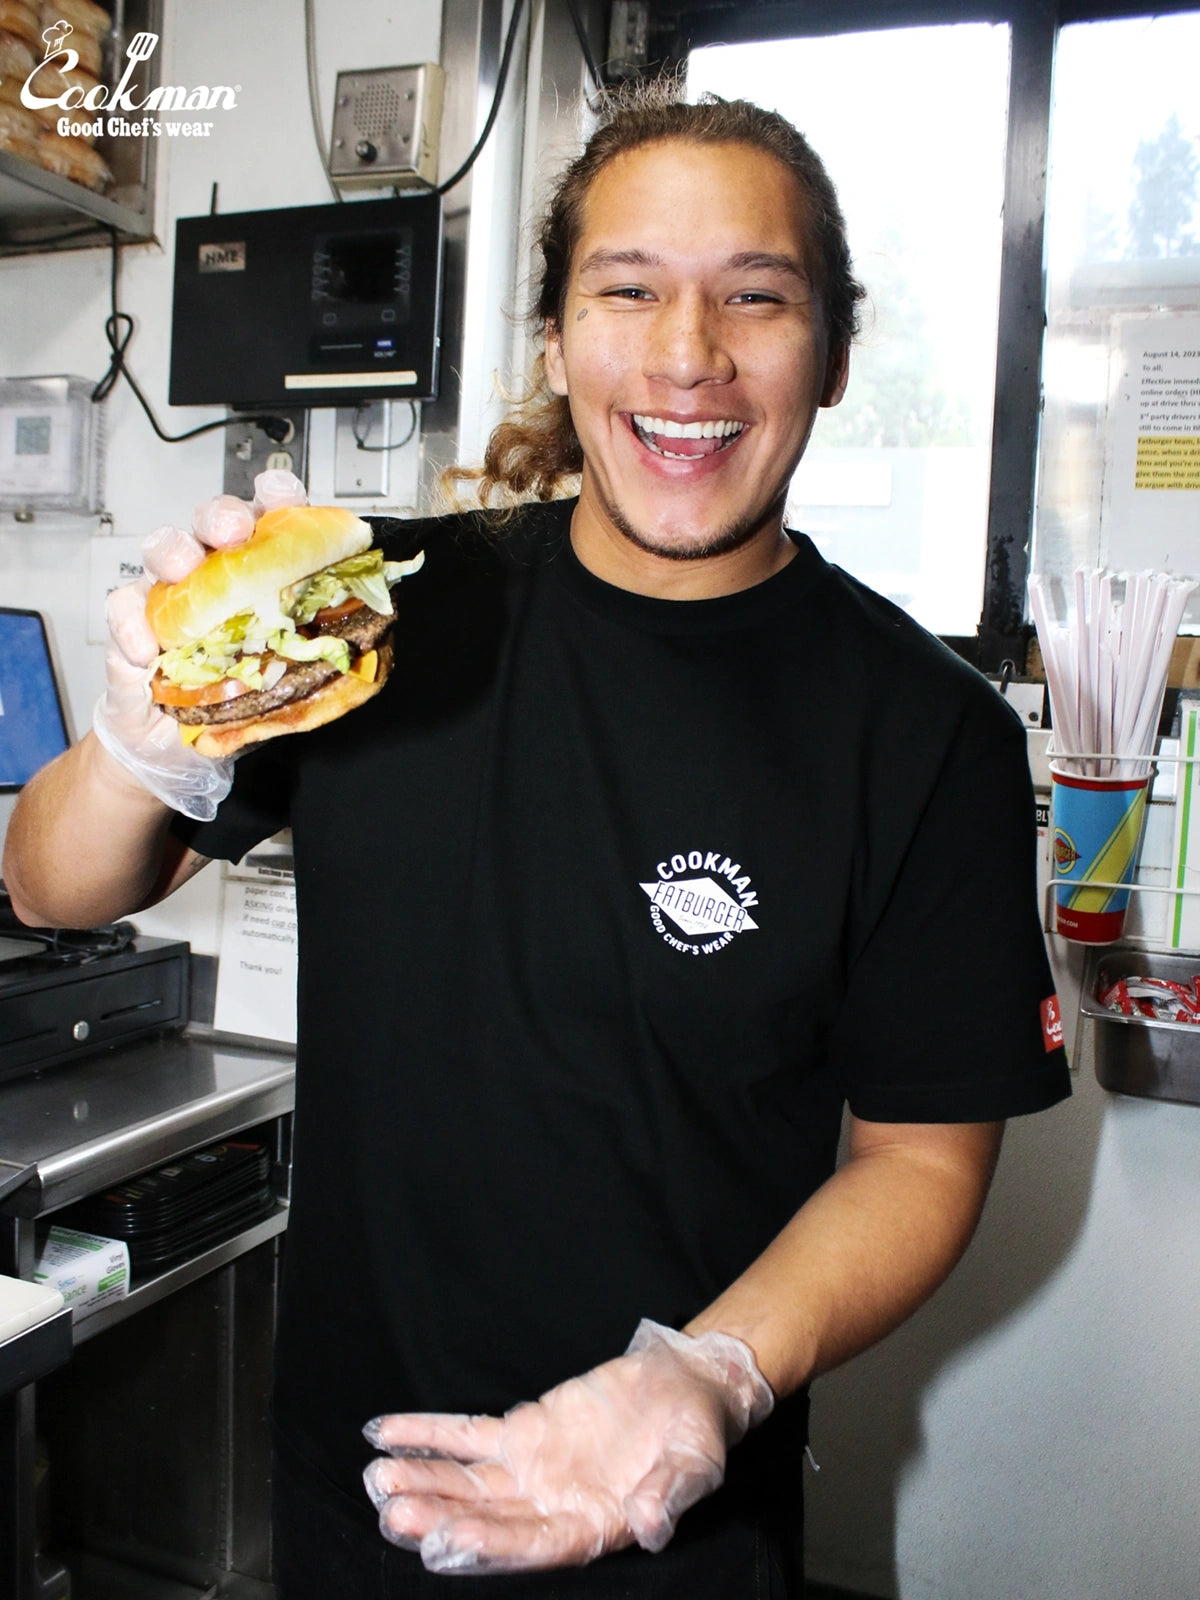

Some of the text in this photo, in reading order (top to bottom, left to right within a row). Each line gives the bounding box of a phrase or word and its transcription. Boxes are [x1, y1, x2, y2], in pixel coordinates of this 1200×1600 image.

[1143, 351, 1168, 359] August
[1170, 351, 1181, 359] 14,
[1138, 437, 1172, 446] Fatburger
[1135, 471, 1150, 479] give
[1144, 483, 1165, 491] argue
[657, 851, 759, 908] COOKMAN
[245, 887, 268, 896] paper
[653, 882, 746, 932] FATBURGER
[250, 916, 271, 925] need
[650, 905, 734, 956] GOOD CHEF'S WEAR
[242, 930, 294, 944] automatically
[240, 961, 262, 972] Thank
